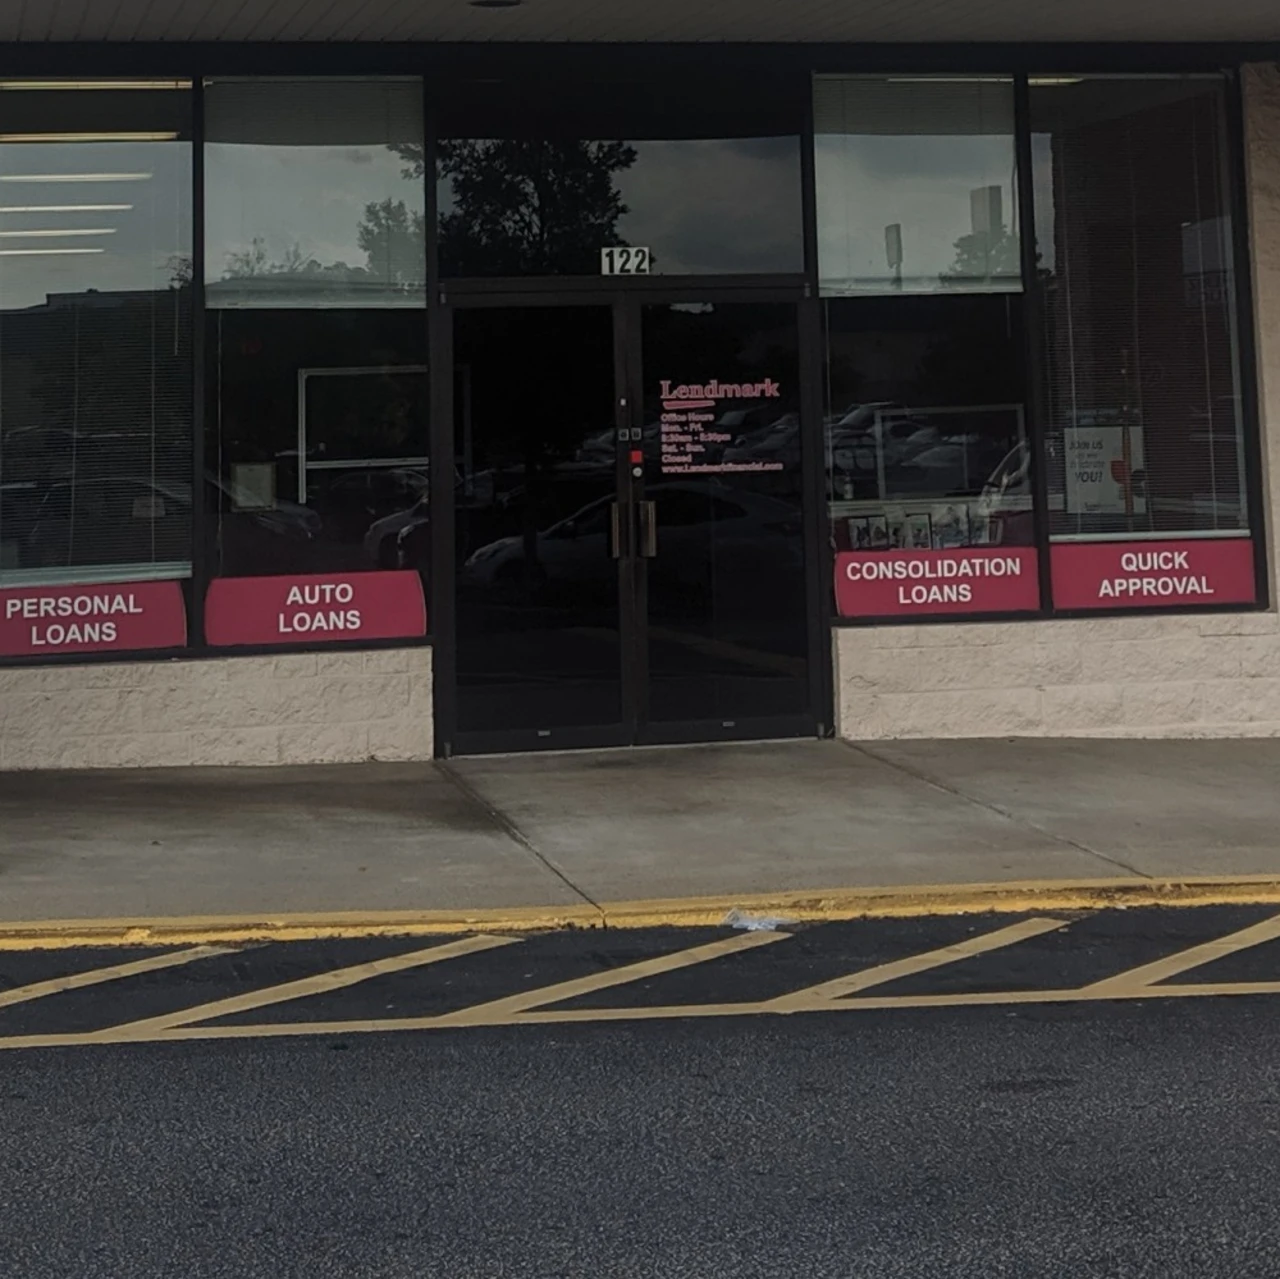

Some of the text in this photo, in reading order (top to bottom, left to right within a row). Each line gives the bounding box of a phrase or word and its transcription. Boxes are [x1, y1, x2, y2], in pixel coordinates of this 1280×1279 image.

[604, 249, 648, 273] 122
[659, 378, 780, 399] Lendmark
[846, 557, 1021, 582] CONSOLIDATION
[1120, 551, 1189, 572] QUICK
[286, 582, 353, 605] AUTO
[898, 583, 972, 605] LOANS
[1098, 575, 1214, 598] APPROVAL
[5, 593, 143, 619] PERSONAL
[278, 609, 361, 634] LOANS
[31, 621, 117, 646] LOANS
